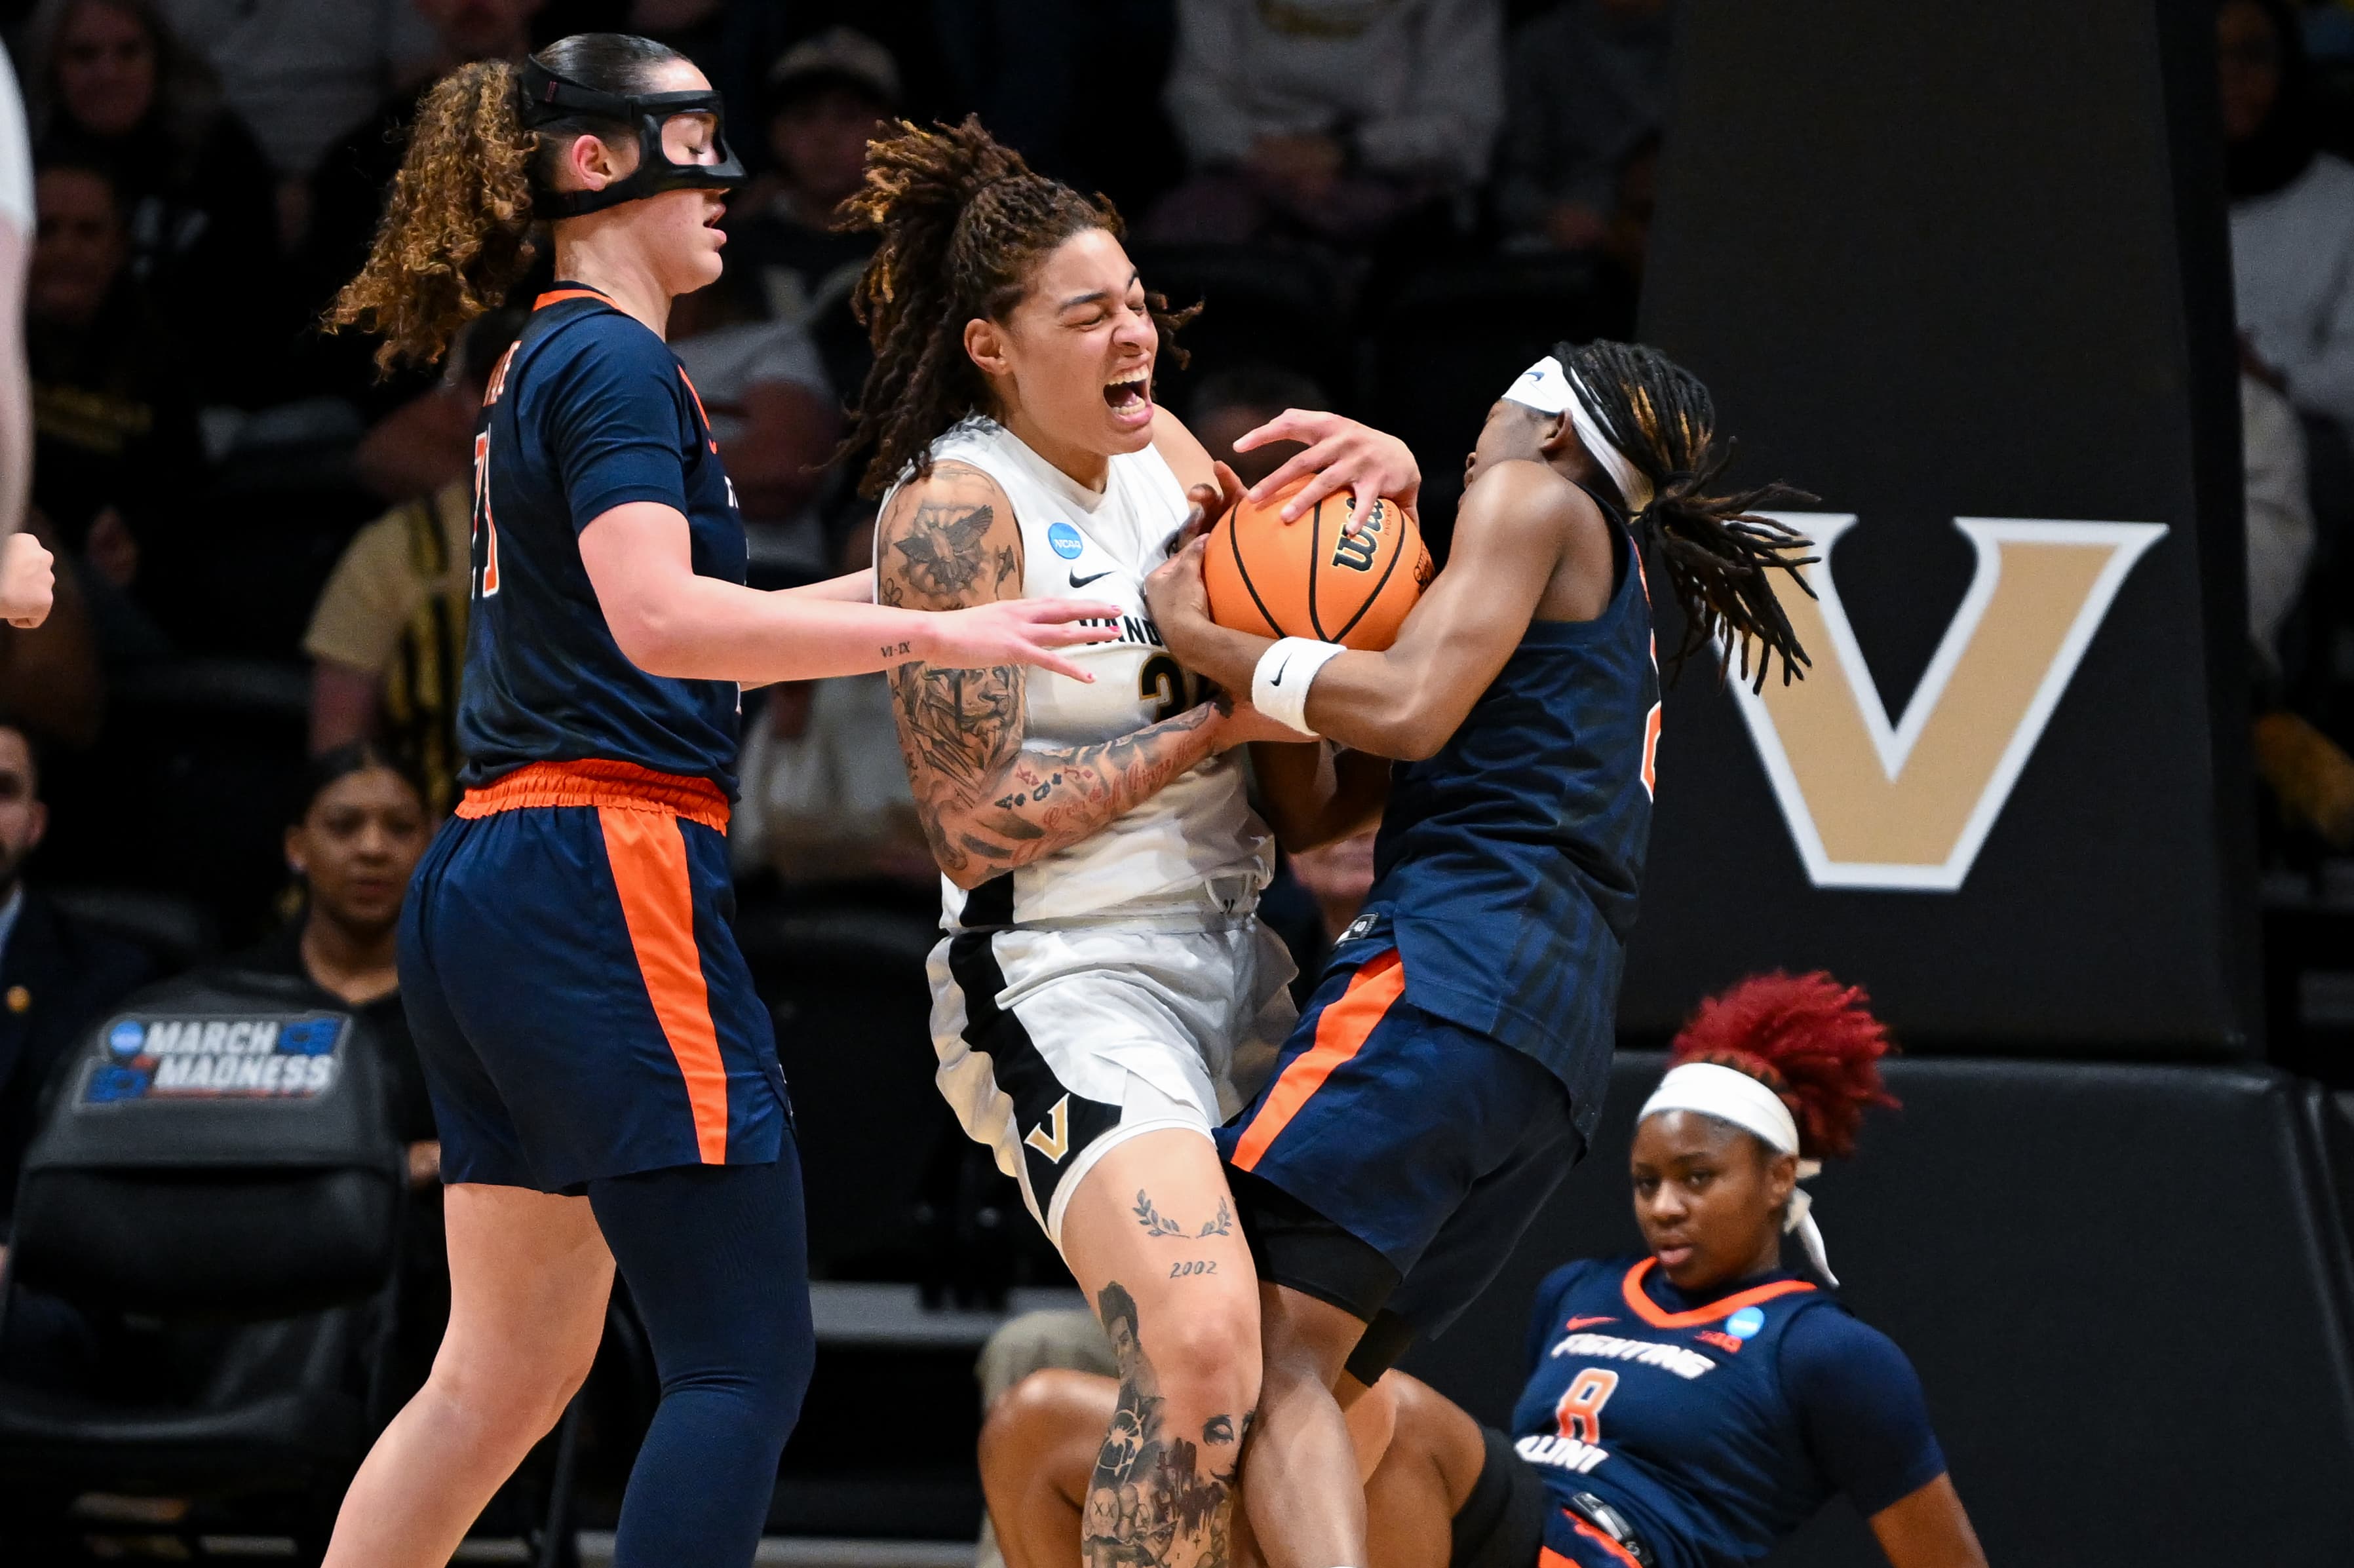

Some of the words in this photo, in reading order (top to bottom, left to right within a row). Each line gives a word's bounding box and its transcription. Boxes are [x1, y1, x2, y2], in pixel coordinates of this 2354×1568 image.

[1054, 539, 1081, 549] NCAA
[1705, 510, 2170, 893] V
[143, 1021, 279, 1054] MARCH
[153, 1054, 333, 1089] MADNESS
[1024, 1092, 1070, 1164] V
[1170, 1261, 1218, 1278] 2002
[1555, 1367, 1619, 1445] 8
